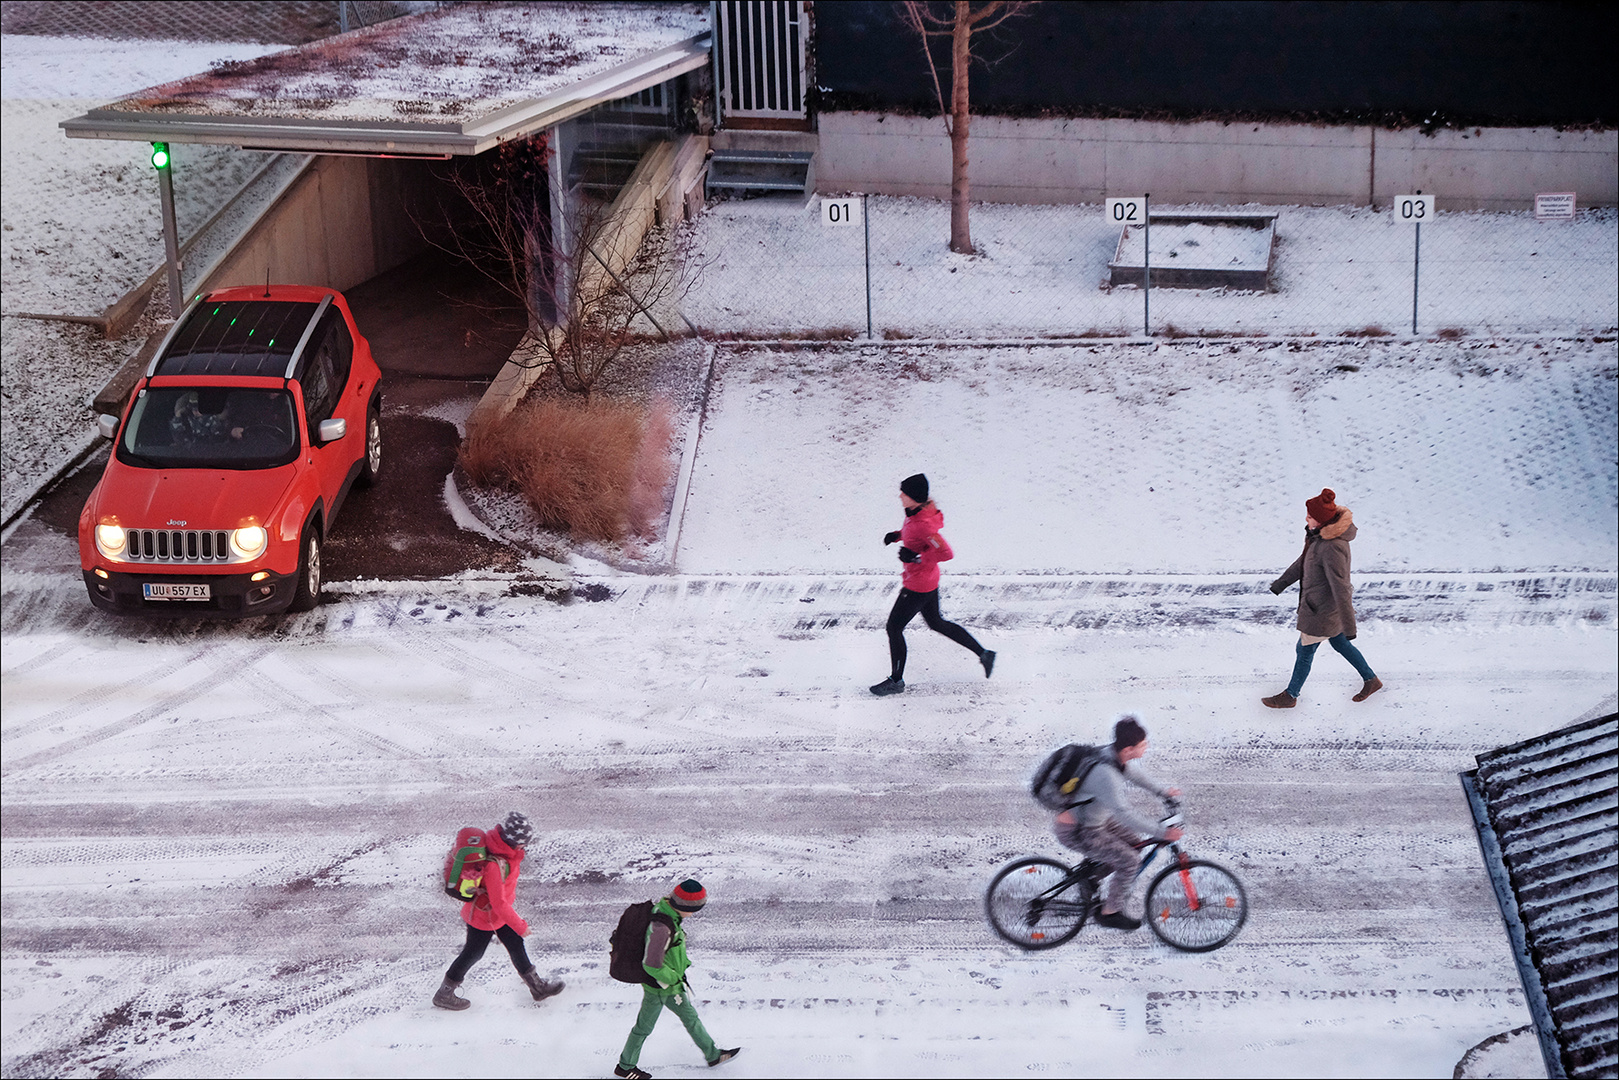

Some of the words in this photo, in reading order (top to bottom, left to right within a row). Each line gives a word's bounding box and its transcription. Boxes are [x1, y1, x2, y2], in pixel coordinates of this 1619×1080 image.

[829, 203, 849, 222] 01
[1113, 202, 1137, 221] 02
[1402, 200, 1425, 219] 03
[166, 519, 187, 527] Jeep
[152, 586, 165, 595] UU
[172, 586, 190, 596] 557
[193, 586, 206, 596] EX
